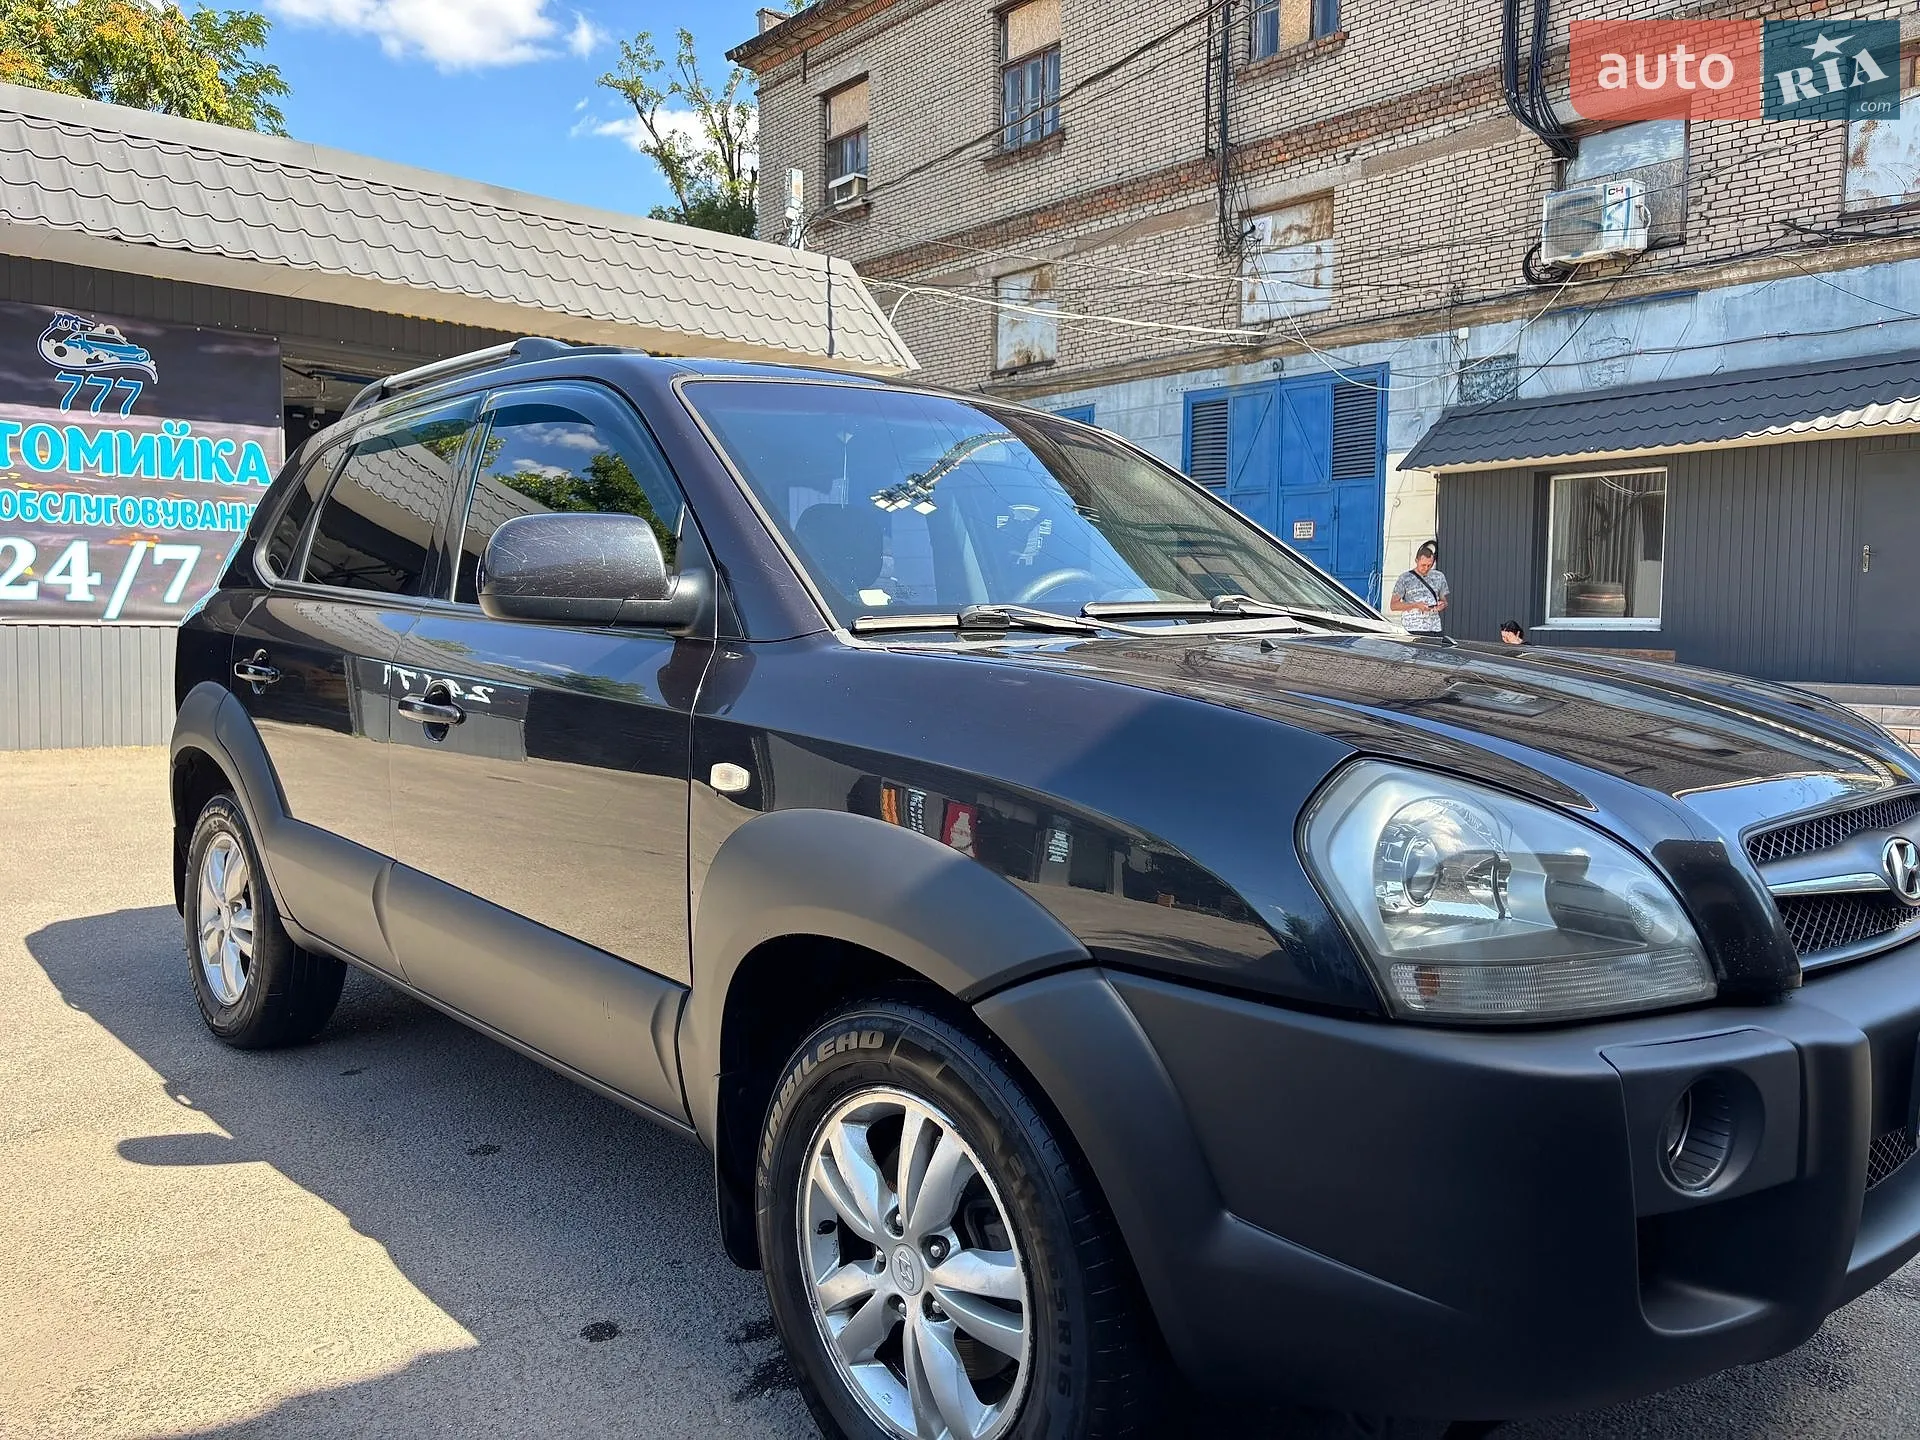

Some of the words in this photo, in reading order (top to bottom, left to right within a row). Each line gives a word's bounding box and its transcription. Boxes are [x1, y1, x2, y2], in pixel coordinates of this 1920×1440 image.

[55, 371, 144, 419] 777
[0, 536, 202, 621] 24/7
[761, 1030, 886, 1169] HABILEAD
